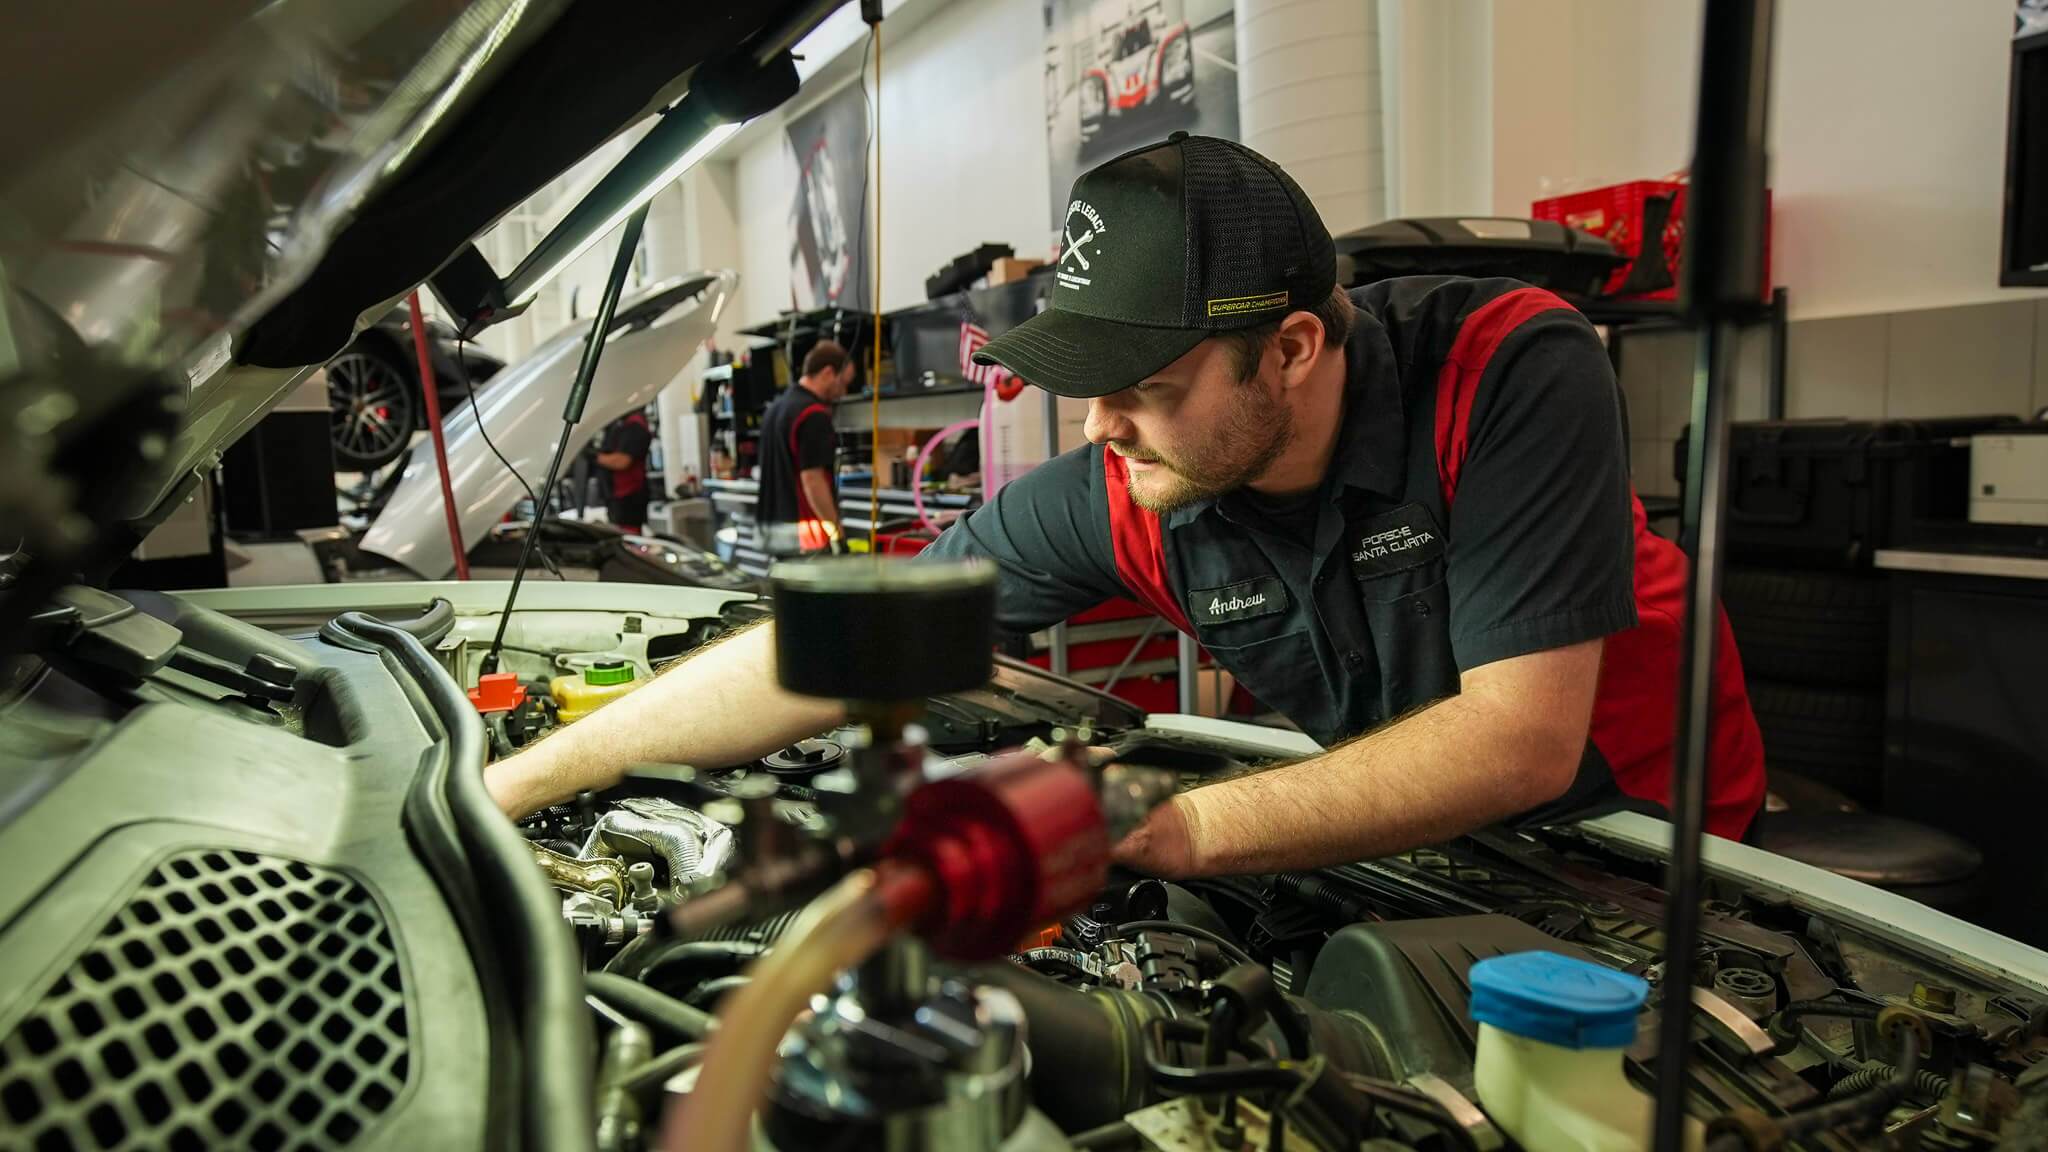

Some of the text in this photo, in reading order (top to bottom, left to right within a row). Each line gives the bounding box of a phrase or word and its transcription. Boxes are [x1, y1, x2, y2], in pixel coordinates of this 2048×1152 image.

[1081, 202, 1106, 234] LEGACY
[1211, 301, 1250, 312] SUPERCAR
[1352, 532, 1435, 562] SANTA CLARITA
[1361, 525, 1412, 548] PORSCHE
[1208, 593, 1266, 615] Andrew
